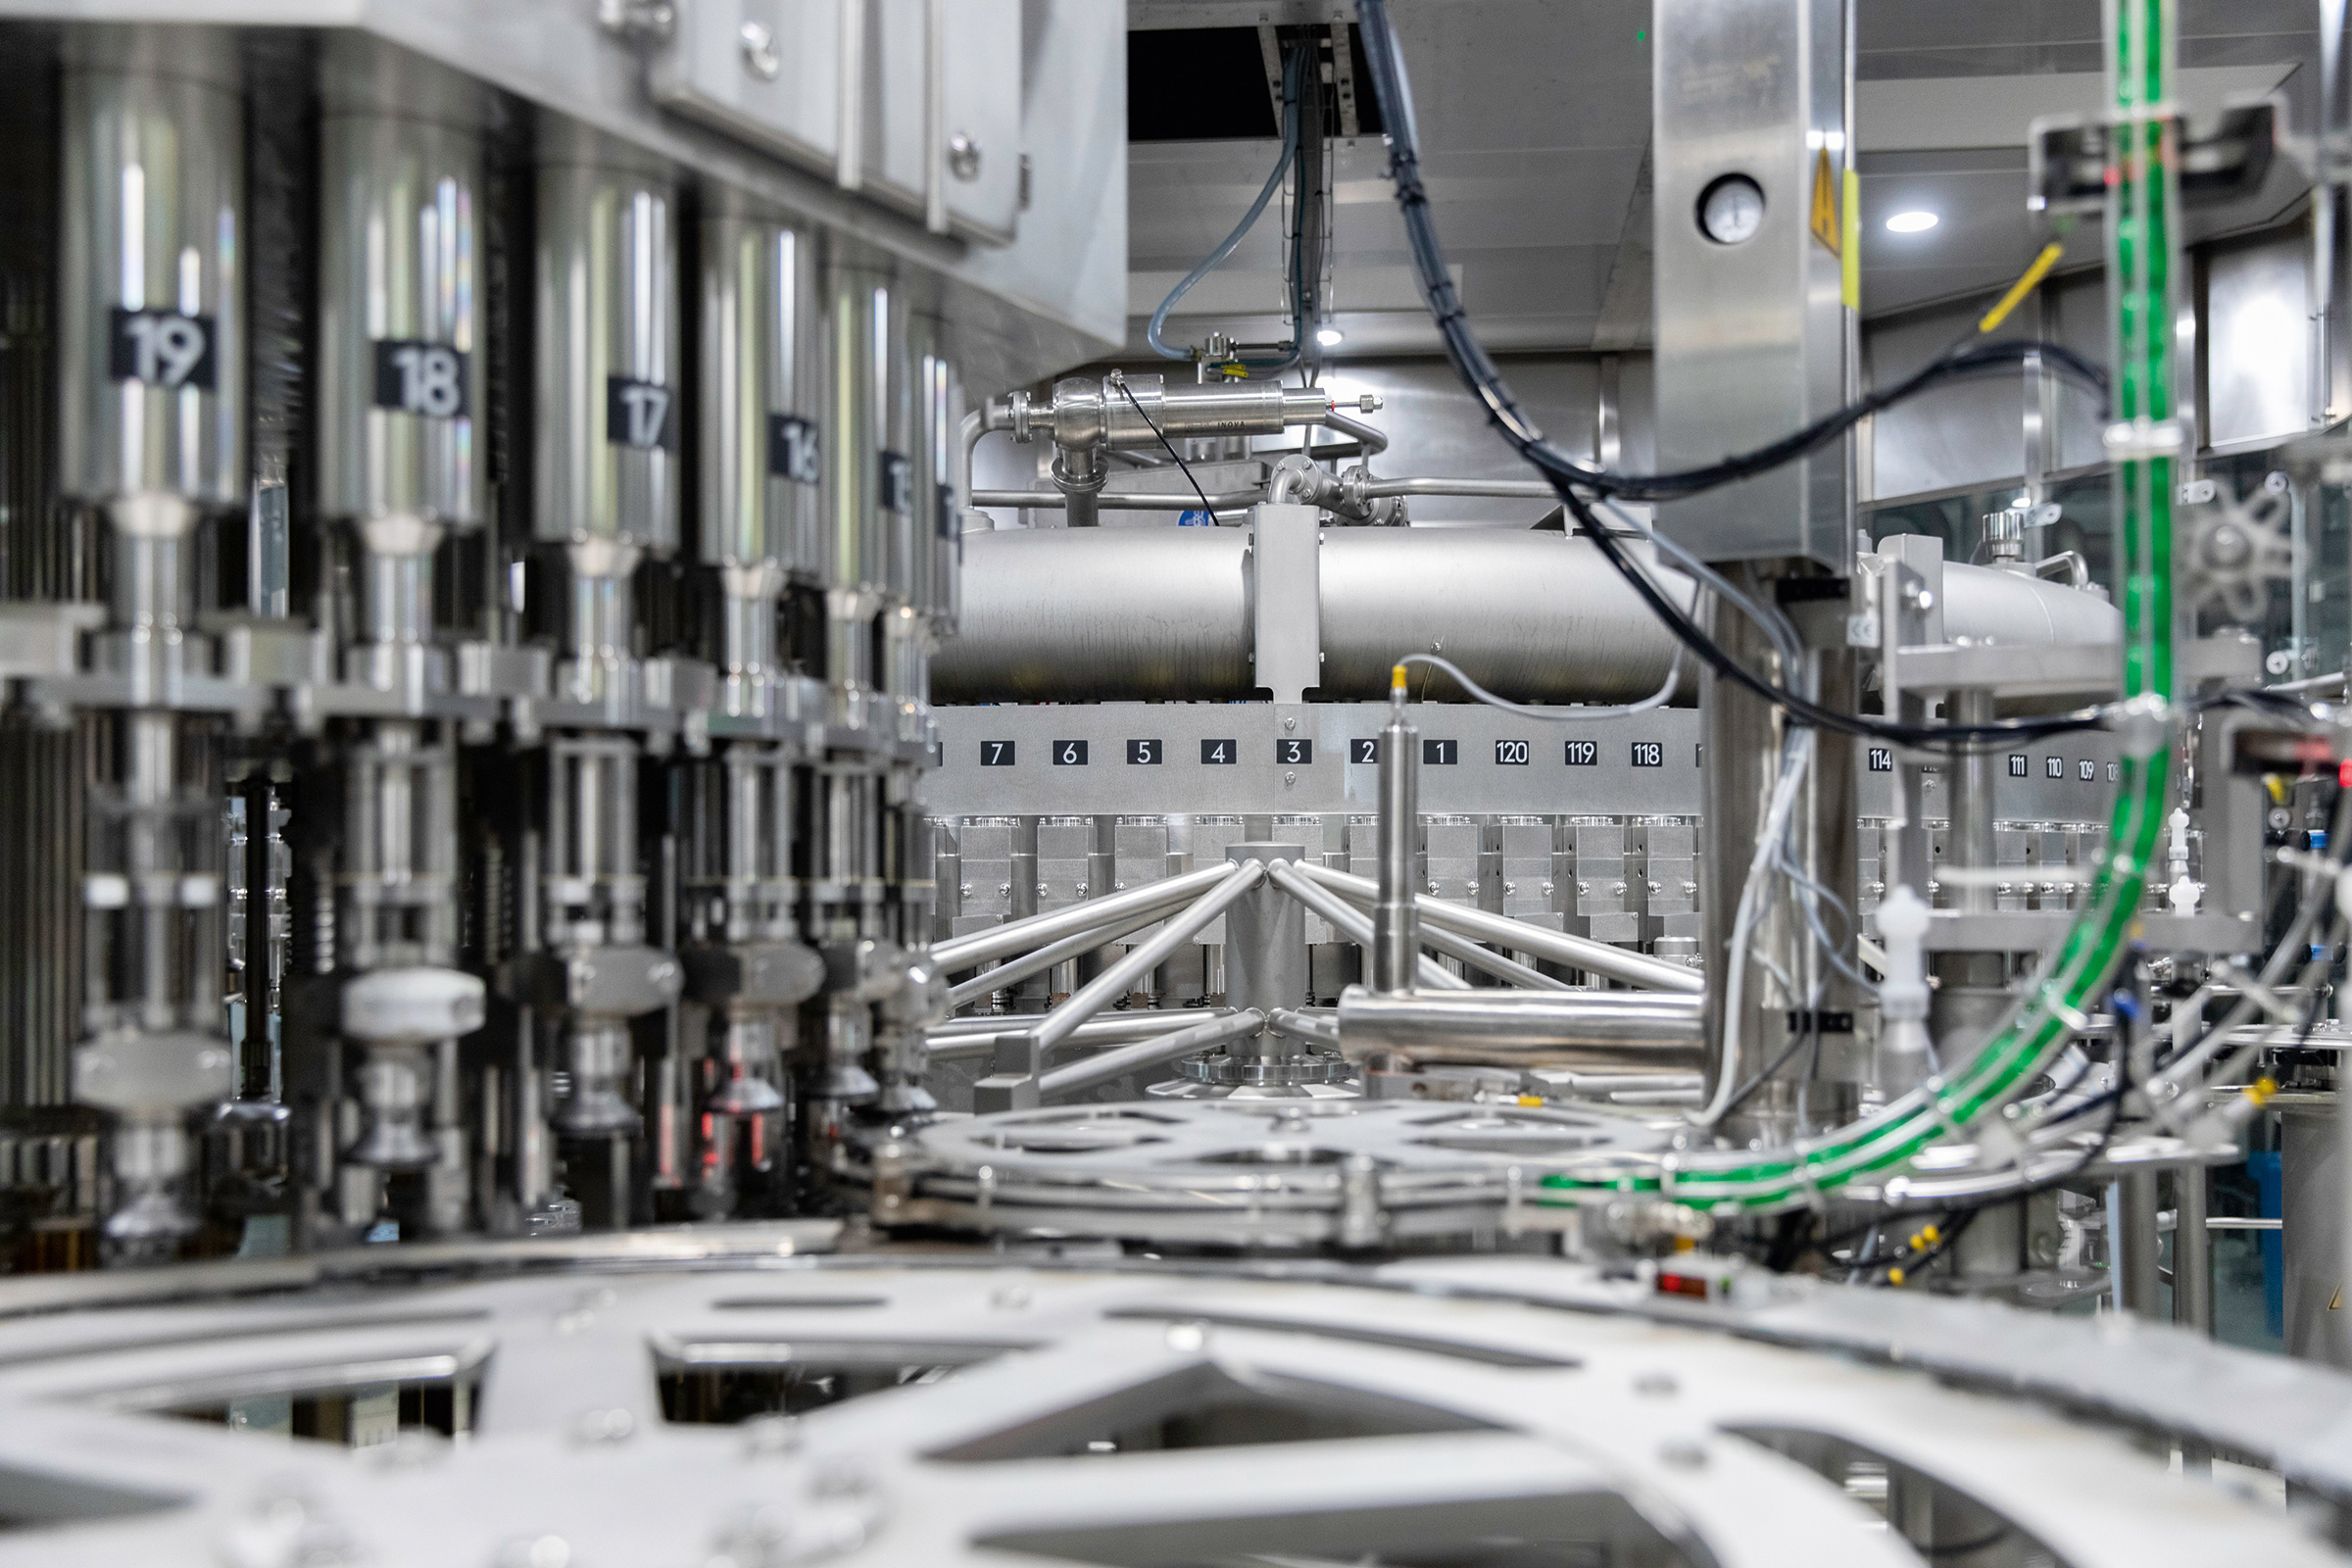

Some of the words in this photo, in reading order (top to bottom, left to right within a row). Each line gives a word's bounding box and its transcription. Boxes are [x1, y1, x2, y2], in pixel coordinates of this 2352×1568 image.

[123, 315, 206, 385] 19
[393, 349, 461, 416] 18
[620, 385, 669, 445] 17
[991, 744, 1004, 764] 7
[1063, 742, 1078, 762] 6
[1137, 741, 1152, 762] 5
[1211, 742, 1226, 763] 4
[1287, 741, 1301, 762] 3
[1362, 741, 1375, 762] 2
[1436, 742, 1445, 762] 1
[1496, 742, 1528, 763] 120
[1567, 742, 1595, 763] 119
[1634, 744, 1660, 764] 118
[1871, 749, 1891, 770] 114
[2011, 756, 2025, 775] 111
[2047, 758, 2063, 777] 110
[2080, 760, 2094, 780] 109
